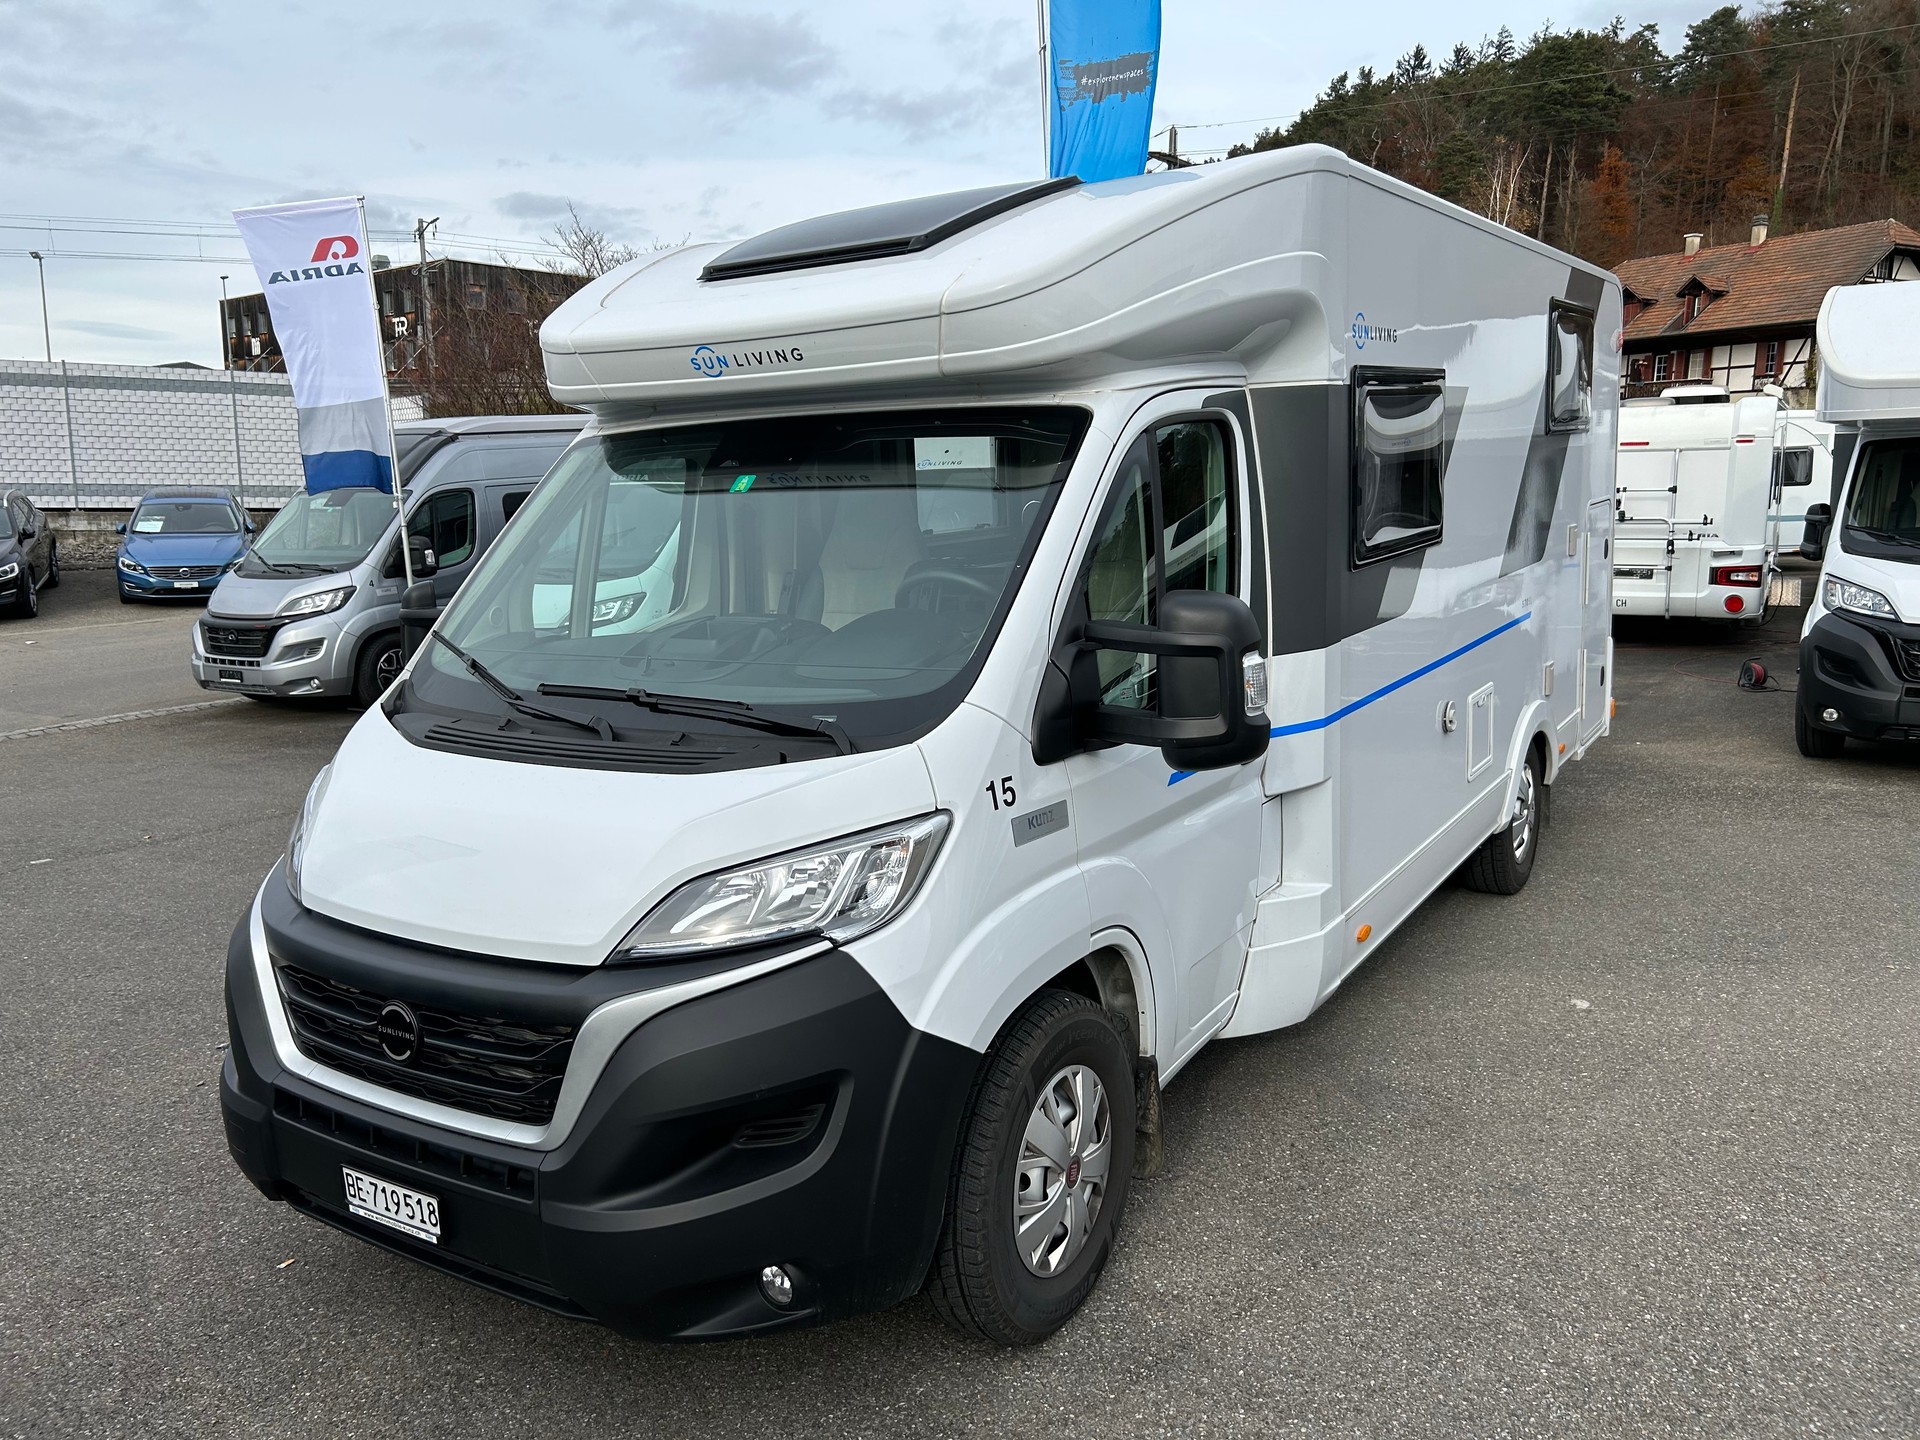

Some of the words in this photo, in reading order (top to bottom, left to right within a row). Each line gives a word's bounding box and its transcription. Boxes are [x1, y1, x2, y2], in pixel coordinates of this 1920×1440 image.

[1080, 68, 1144, 87] #explorenewspaces
[1352, 323, 1398, 343] SUNLIVING
[690, 354, 730, 371] SUN
[733, 347, 804, 367] LIVING
[1615, 599, 1627, 608] CH
[985, 775, 1017, 811] 15
[378, 1025, 415, 1040] SUNLIVING
